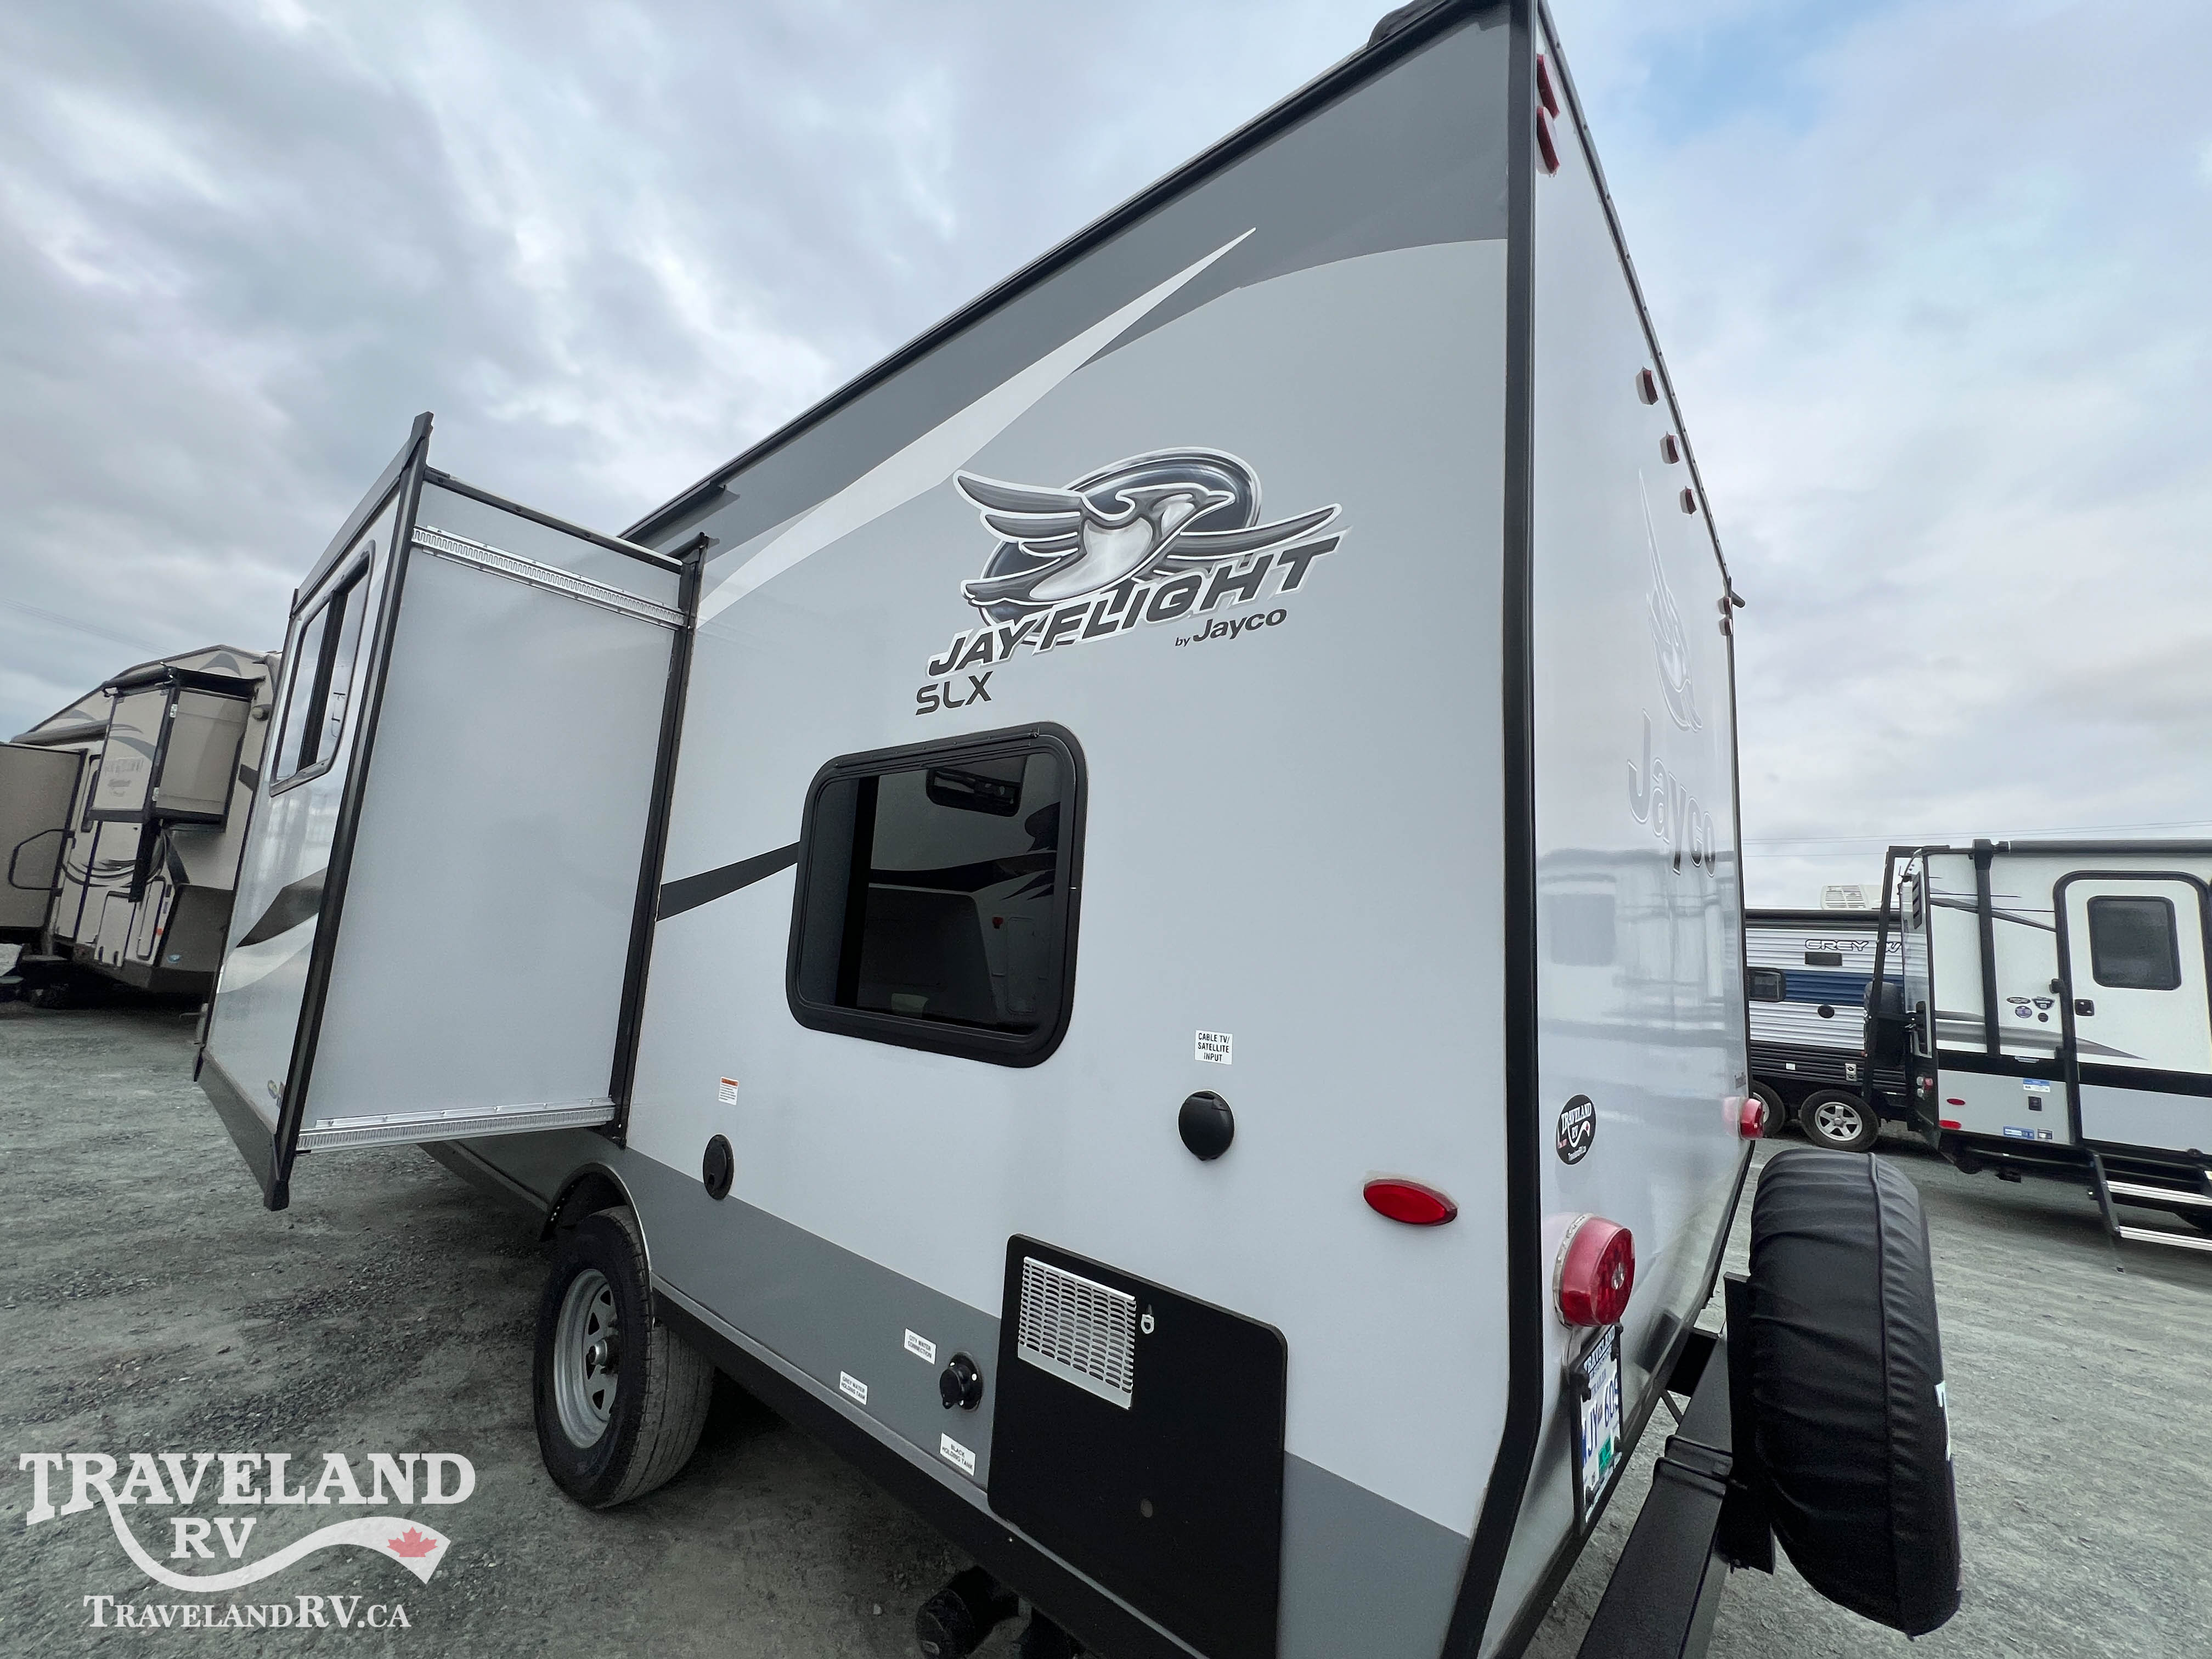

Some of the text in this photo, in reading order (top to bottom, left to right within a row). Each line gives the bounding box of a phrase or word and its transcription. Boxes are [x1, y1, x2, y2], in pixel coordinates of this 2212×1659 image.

[1040, 535, 1340, 651] FLIGHT
[1175, 608, 1288, 647] by Jayco
[915, 670, 994, 715] SLX
[1627, 708, 1715, 877] Jayco
[1805, 939, 1869, 951] GREY
[1198, 1032, 1230, 1044] CABLE TV/
[1198, 1042, 1229, 1053] SATELLITE
[1203, 1052, 1223, 1062] INPUT
[1583, 1324, 1615, 1374] TRAVELAND
